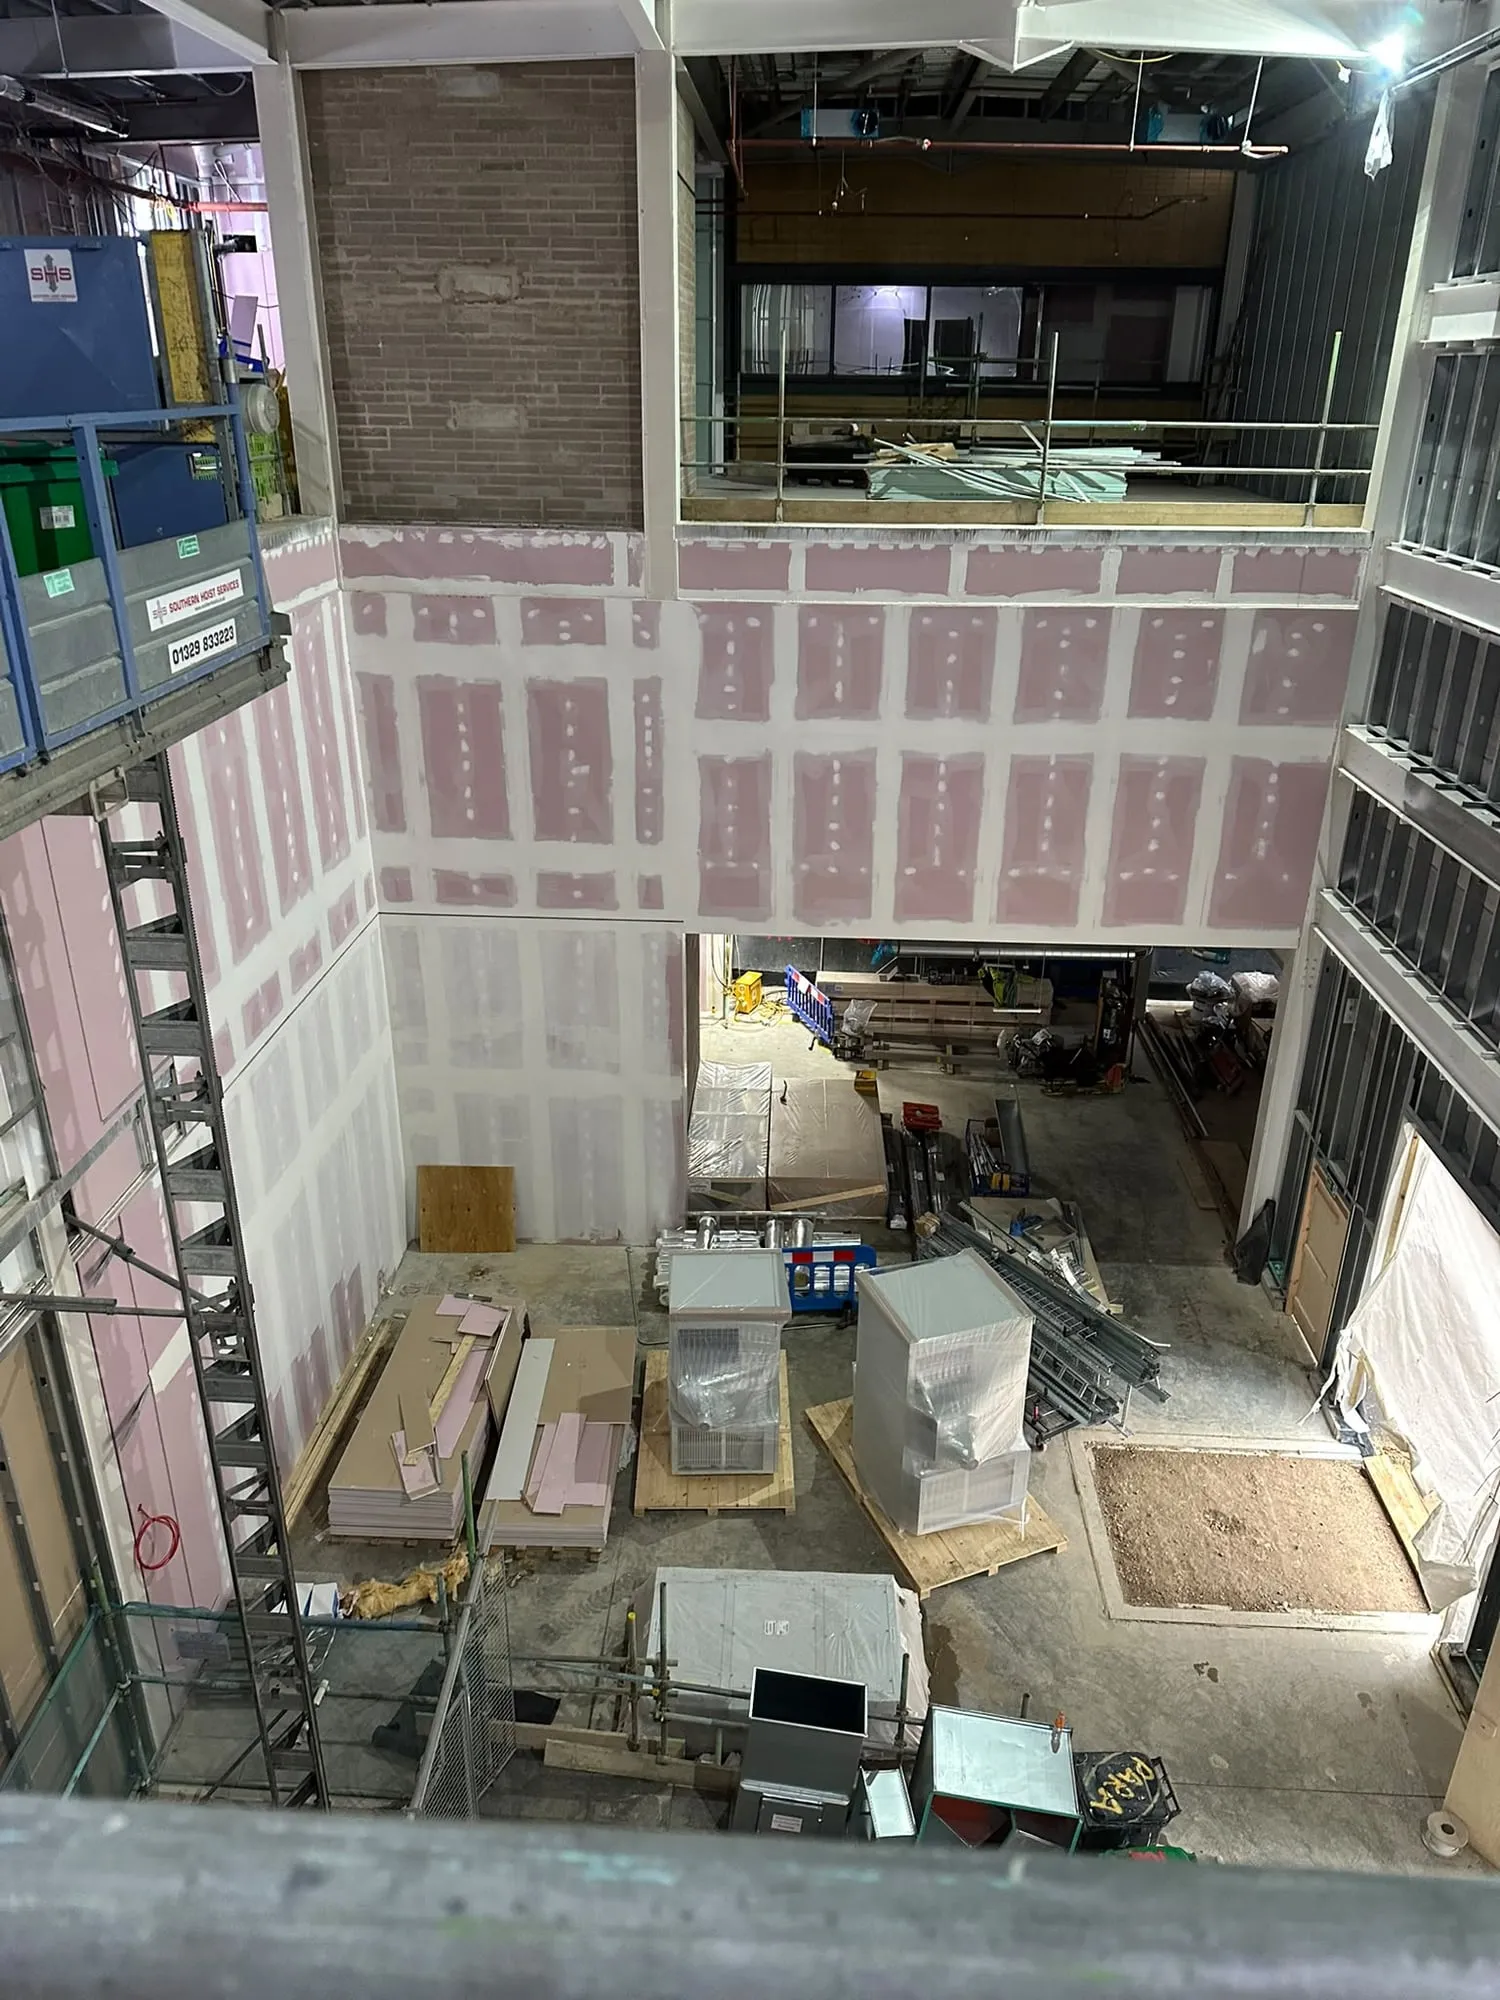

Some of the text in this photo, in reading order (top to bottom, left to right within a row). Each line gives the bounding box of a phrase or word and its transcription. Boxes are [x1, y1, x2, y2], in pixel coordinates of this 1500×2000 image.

[31, 266, 72, 283] SHS
[168, 593, 200, 613] SOUTHERN
[200, 588, 216, 601] HOIST
[216, 579, 240, 596] SERVICES
[172, 625, 235, 665] 01329 833223
